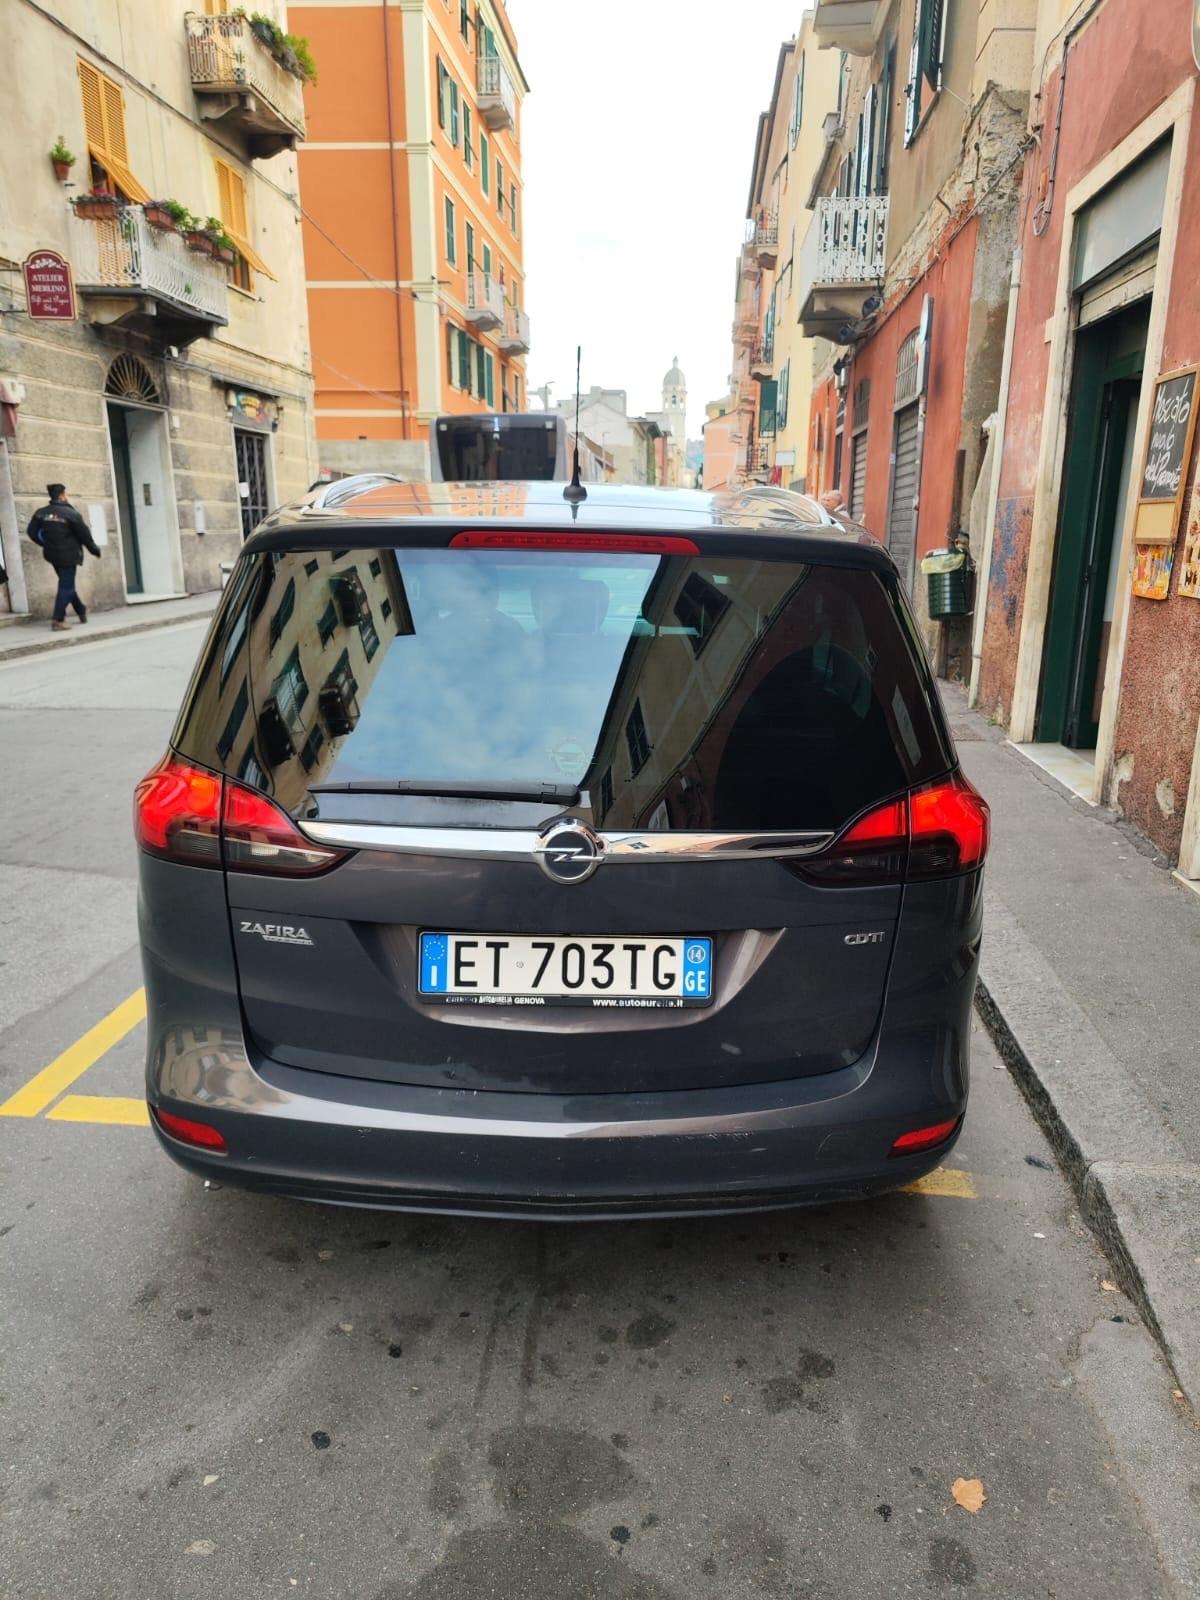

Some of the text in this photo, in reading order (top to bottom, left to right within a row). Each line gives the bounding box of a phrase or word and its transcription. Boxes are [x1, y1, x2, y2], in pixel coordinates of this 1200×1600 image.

[32, 274, 64, 282] ATELIER
[31, 284, 67, 293] MERLINO
[240, 921, 310, 939] ZAFIRA
[690, 949, 702, 961] 14
[454, 941, 510, 988] ET
[531, 942, 677, 991] 703TG
[684, 970, 706, 992] GE
[514, 997, 545, 1005] GENOVA
